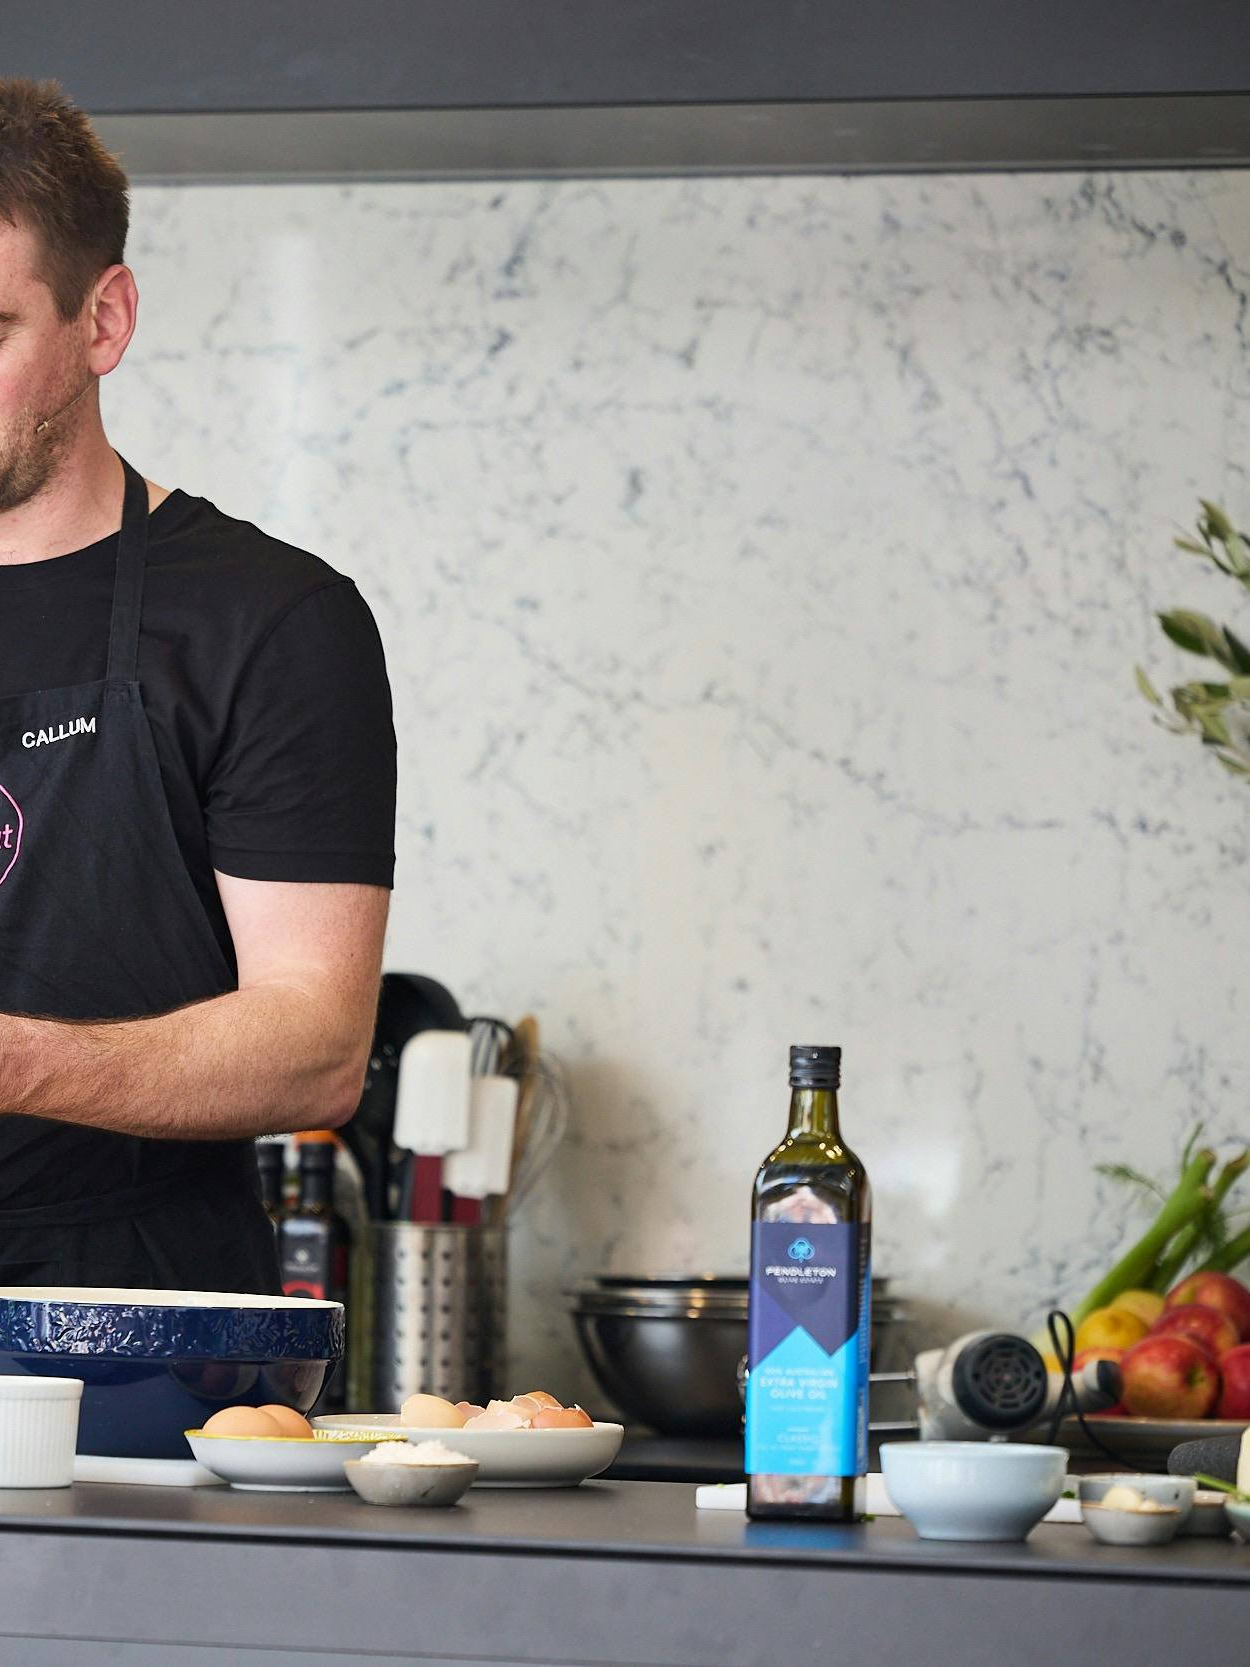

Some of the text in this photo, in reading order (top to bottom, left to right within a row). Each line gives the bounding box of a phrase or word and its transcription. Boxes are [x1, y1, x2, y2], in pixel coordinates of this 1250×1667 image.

[21, 717, 97, 748] CALLUM
[765, 1265, 837, 1277] PENDLETON
[759, 1377, 839, 1389] EXTRA VIRGIN
[770, 1388, 827, 1400] OLIVE OIL
